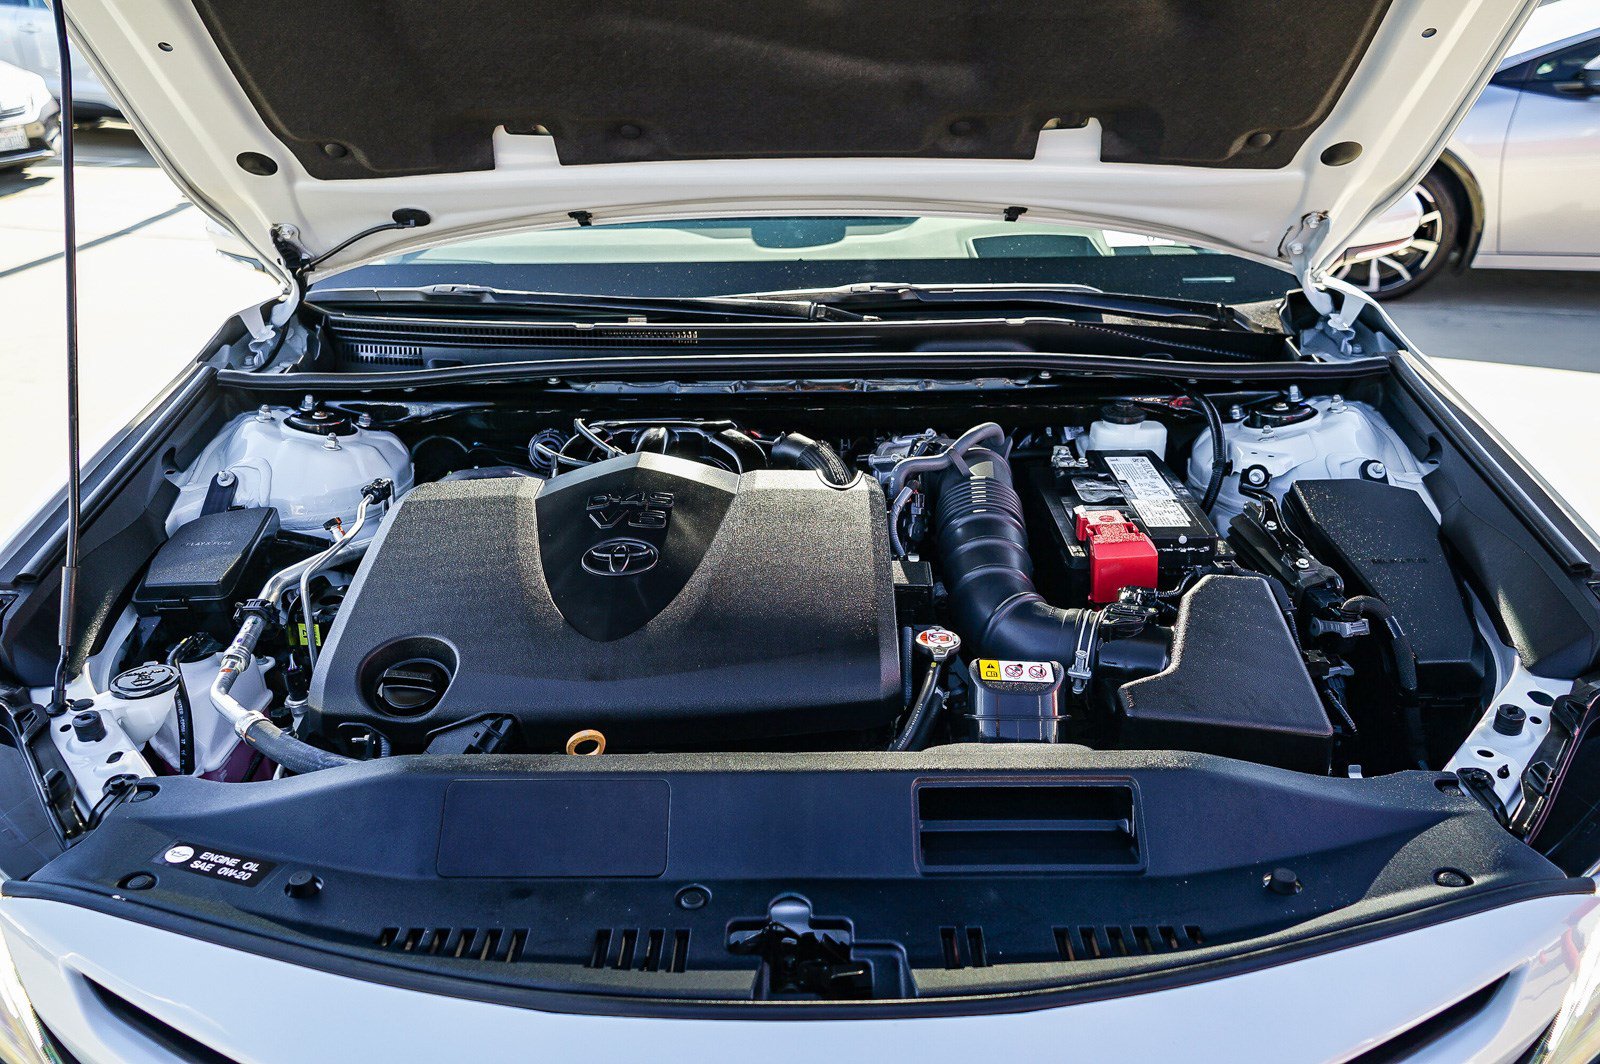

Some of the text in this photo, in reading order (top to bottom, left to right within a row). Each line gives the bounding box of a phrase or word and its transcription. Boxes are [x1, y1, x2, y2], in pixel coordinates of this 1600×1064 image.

[586, 491, 675, 511] D-4S
[588, 510, 667, 529] V6
[190, 861, 252, 881] SAE 0W-20
[200, 852, 260, 872] ENGINE OIL
